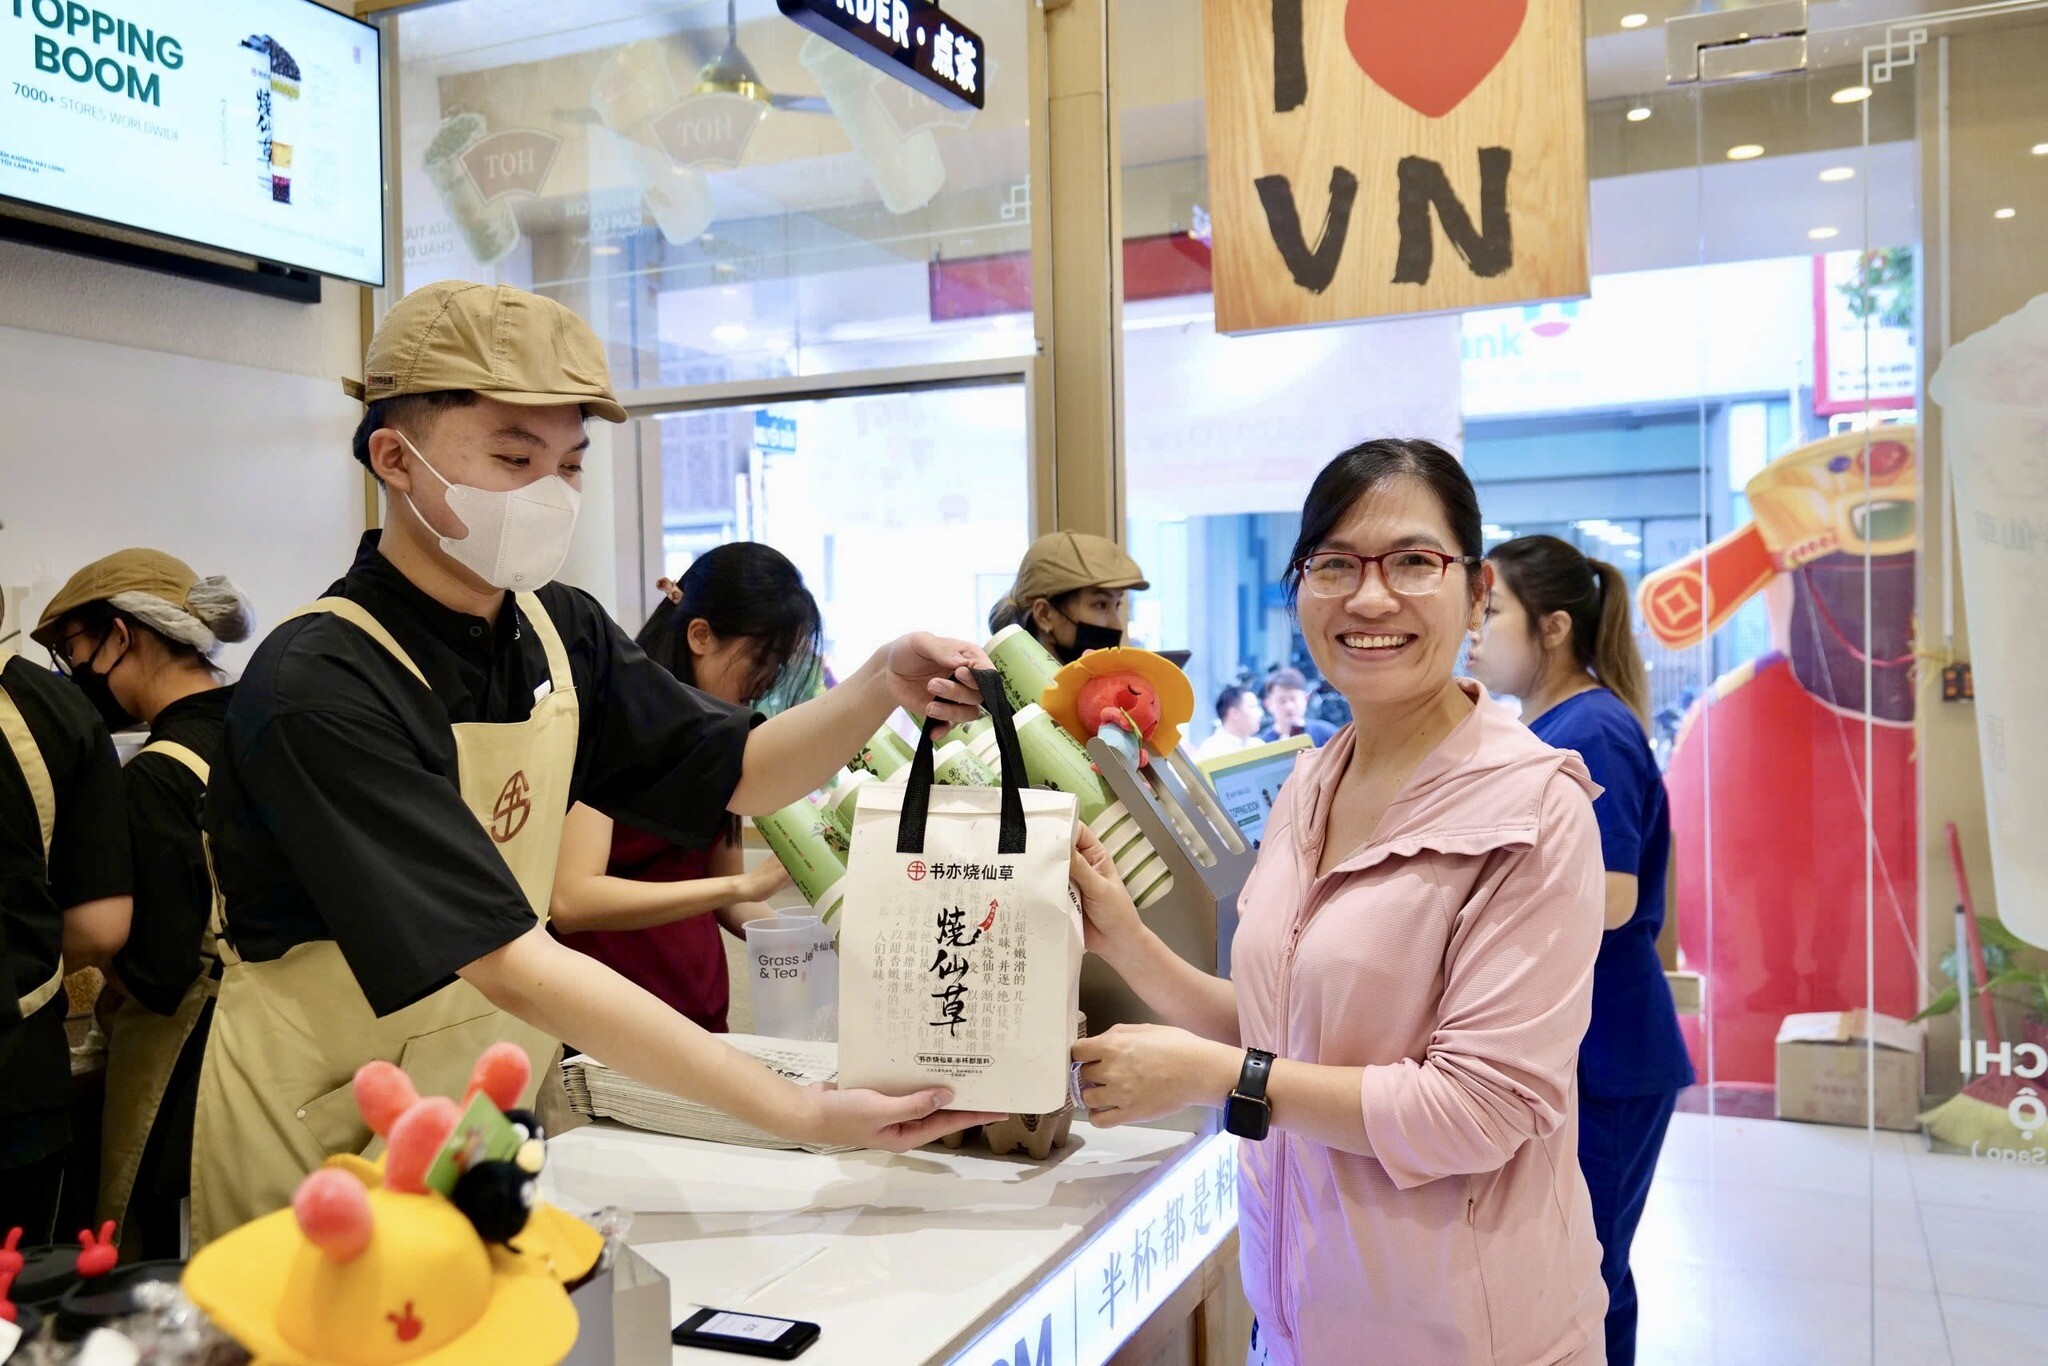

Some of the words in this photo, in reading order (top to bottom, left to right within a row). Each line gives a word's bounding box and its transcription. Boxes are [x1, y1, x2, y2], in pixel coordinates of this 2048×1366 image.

[35, 33, 160, 107] BOOM
[932, 23, 977, 93] 点茶
[1272, 0, 1309, 114] I
[12, 81, 55, 104] 7000+
[60, 96, 107, 121] STORES
[1254, 146, 1513, 295] VN
[930, 863, 1014, 881] 书亦烧仙草
[758, 954, 799, 966] Grass
[760, 967, 770, 979] &
[773, 968, 798, 979] Tea
[1098, 1144, 1237, 1331] 半杯都是料
